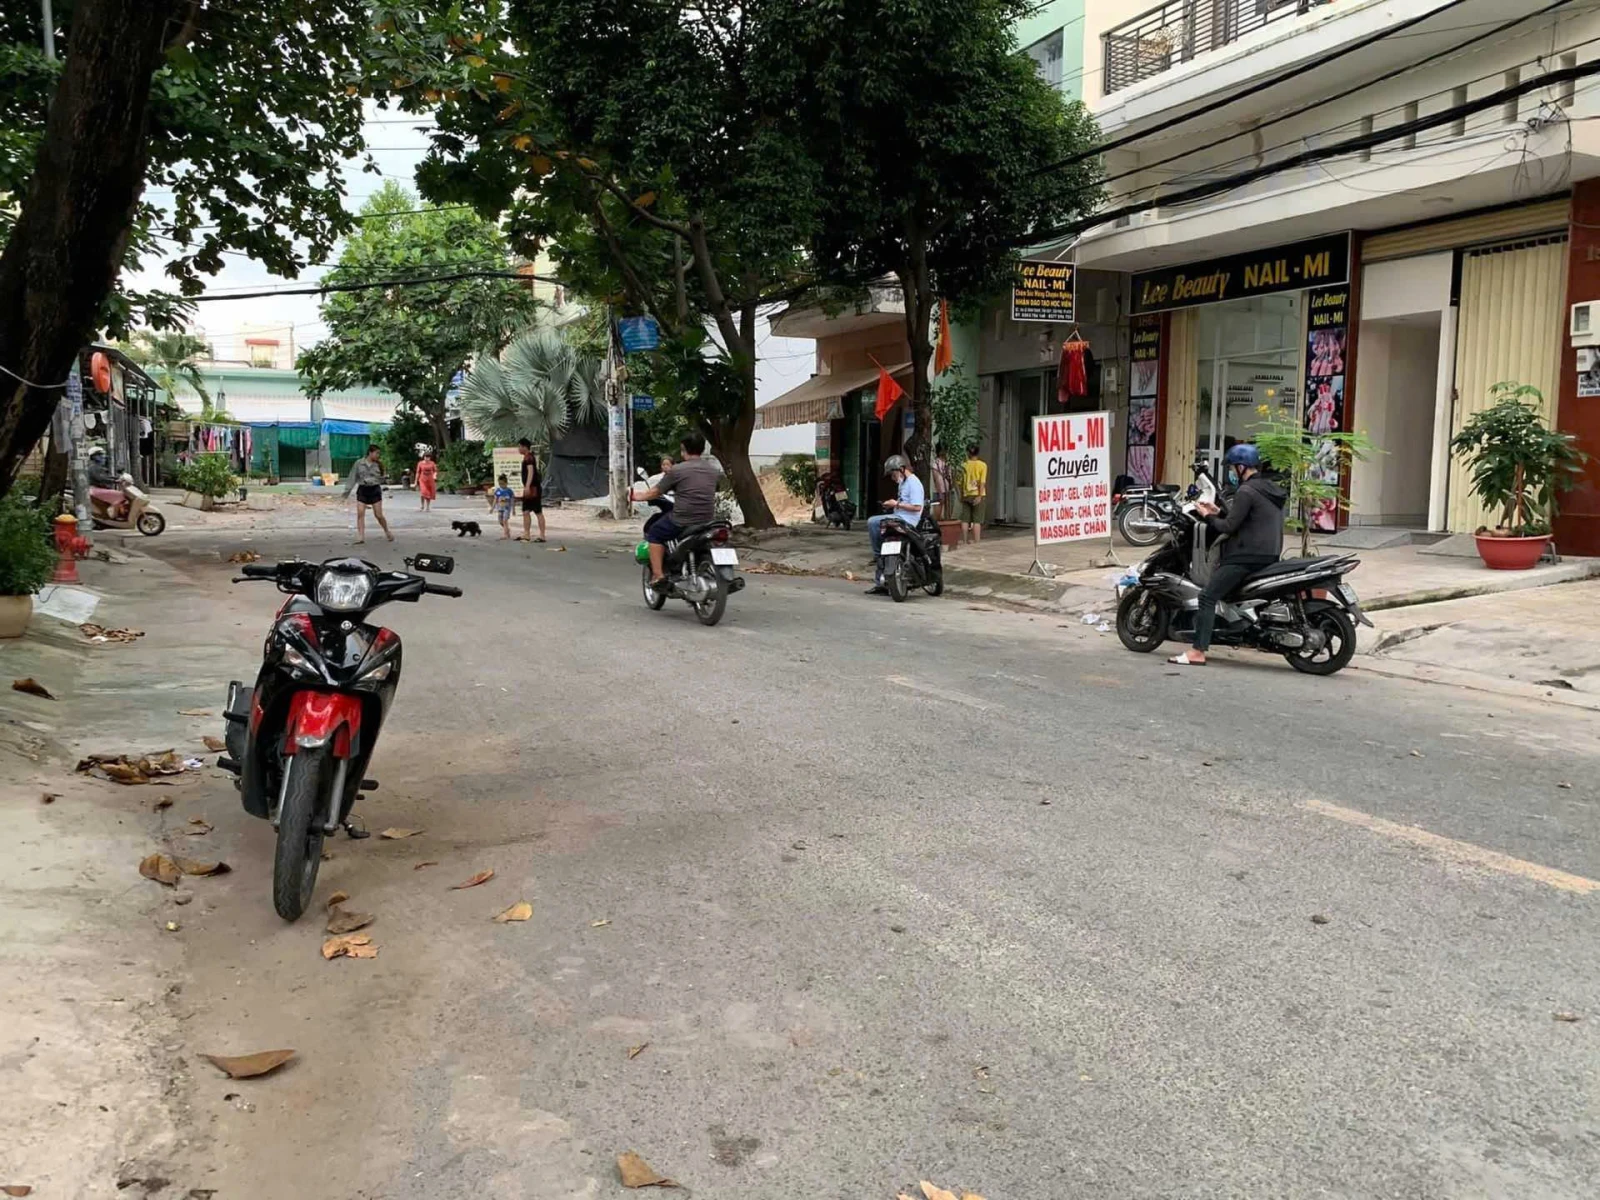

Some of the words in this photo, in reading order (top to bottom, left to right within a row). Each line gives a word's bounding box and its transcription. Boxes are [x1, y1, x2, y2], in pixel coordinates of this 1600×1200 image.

[1036, 264, 1072, 281] Beauty
[1141, 280, 1168, 305] Lee
[1172, 268, 1230, 300] Beauty
[1244, 259, 1290, 289] NAIL
[1303, 251, 1331, 279] MI
[1038, 420, 1075, 452] NAIL
[1087, 417, 1104, 448] MI
[1048, 454, 1098, 478] Chuyên
[1040, 523, 1081, 540] MASSAGE
